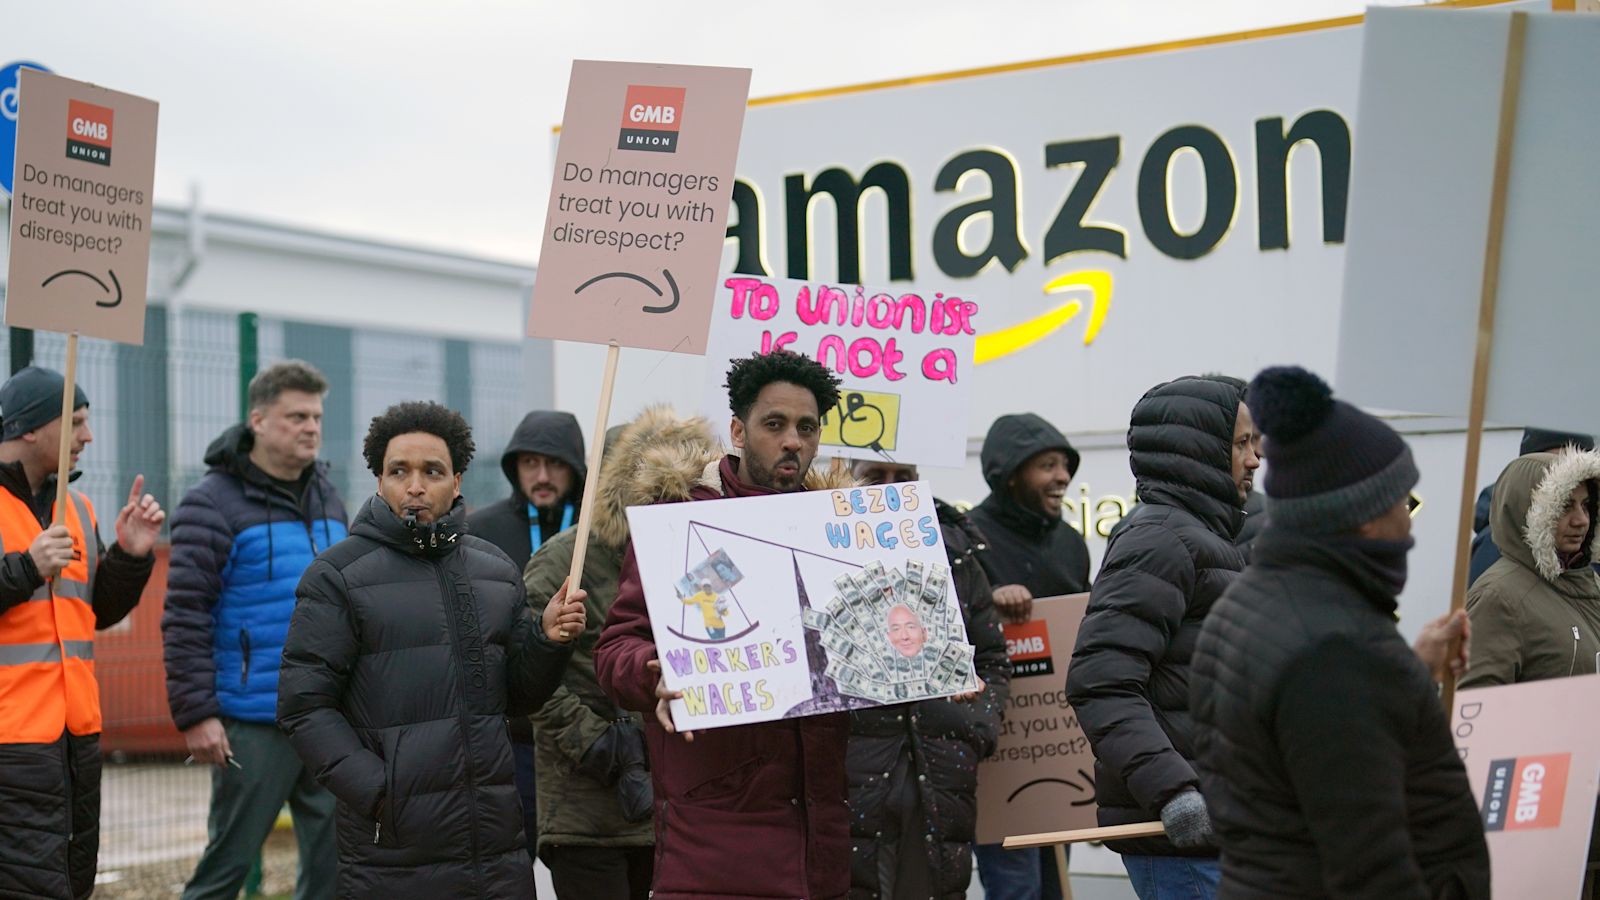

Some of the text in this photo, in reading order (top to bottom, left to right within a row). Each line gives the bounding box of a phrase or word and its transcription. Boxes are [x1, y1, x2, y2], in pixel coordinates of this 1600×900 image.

[72, 118, 108, 141] GMB
[629, 104, 675, 125] GMB
[72, 146, 106, 160] UNION
[626, 135, 670, 146] UNION
[23, 163, 144, 205] Do managers
[563, 162, 719, 196] Do managers
[21, 193, 142, 232] treat you with
[559, 192, 714, 223] treat you with
[722, 107, 1352, 286] amazon
[19, 221, 123, 255] disrespect?
[553, 222, 685, 253] disrespect?
[921, 348, 958, 385] a
[831, 484, 920, 517] BEZOS
[825, 516, 939, 549] WAGES
[450, 571, 485, 689] ALESSANDRO
[1006, 636, 1045, 656] GMB
[666, 639, 797, 677] WORKER'S
[680, 679, 774, 717] WAGES
[1020, 717, 1058, 738] you
[1456, 702, 1482, 738] Do
[986, 737, 1087, 764] srespect?
[1487, 767, 1506, 824] UNION
[1515, 762, 1546, 824] GMB
